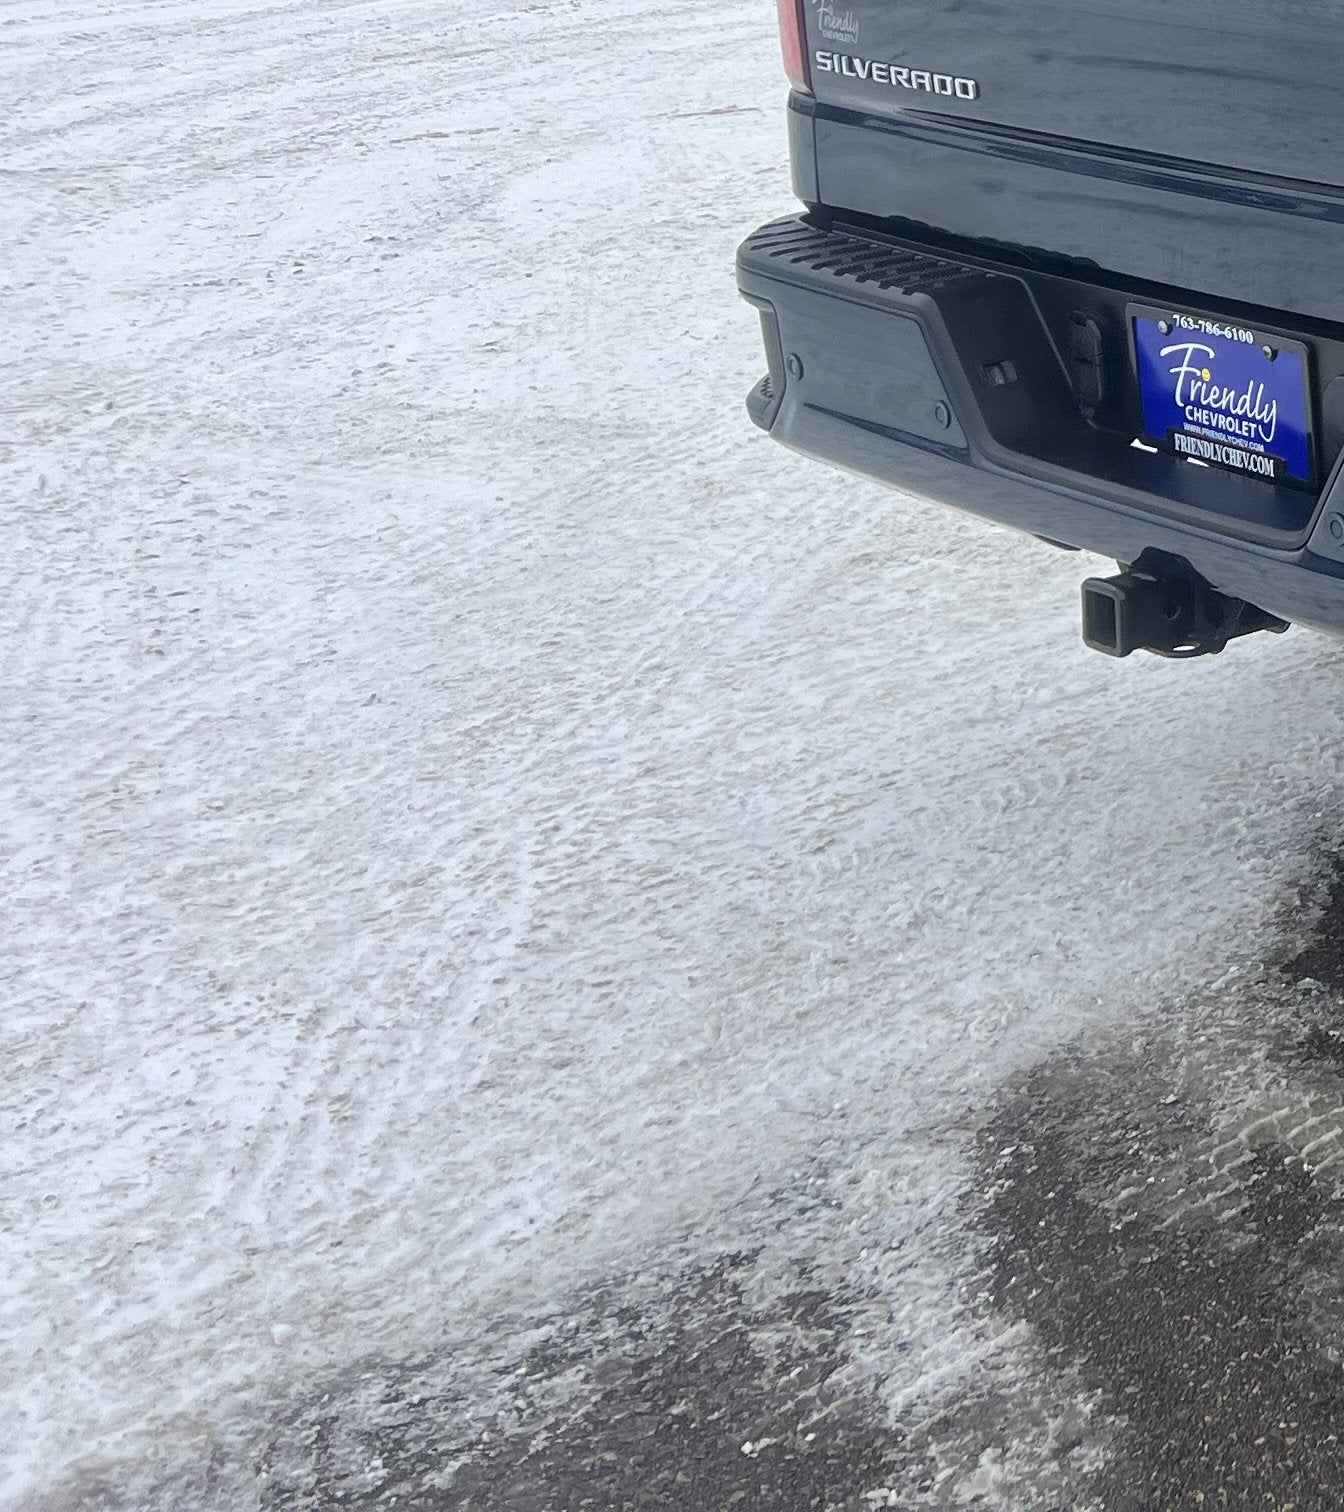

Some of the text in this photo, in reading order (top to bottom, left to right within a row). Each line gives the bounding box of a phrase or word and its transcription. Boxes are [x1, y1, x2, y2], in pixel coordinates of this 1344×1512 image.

[815, 50, 978, 100] SILVERADO
[1172, 314, 1254, 345] 763-786-6100
[1160, 343, 1276, 443] Friendly
[1185, 405, 1257, 438] CHEVROLET
[1174, 433, 1275, 478] FRIENDLYCHEV.COM
